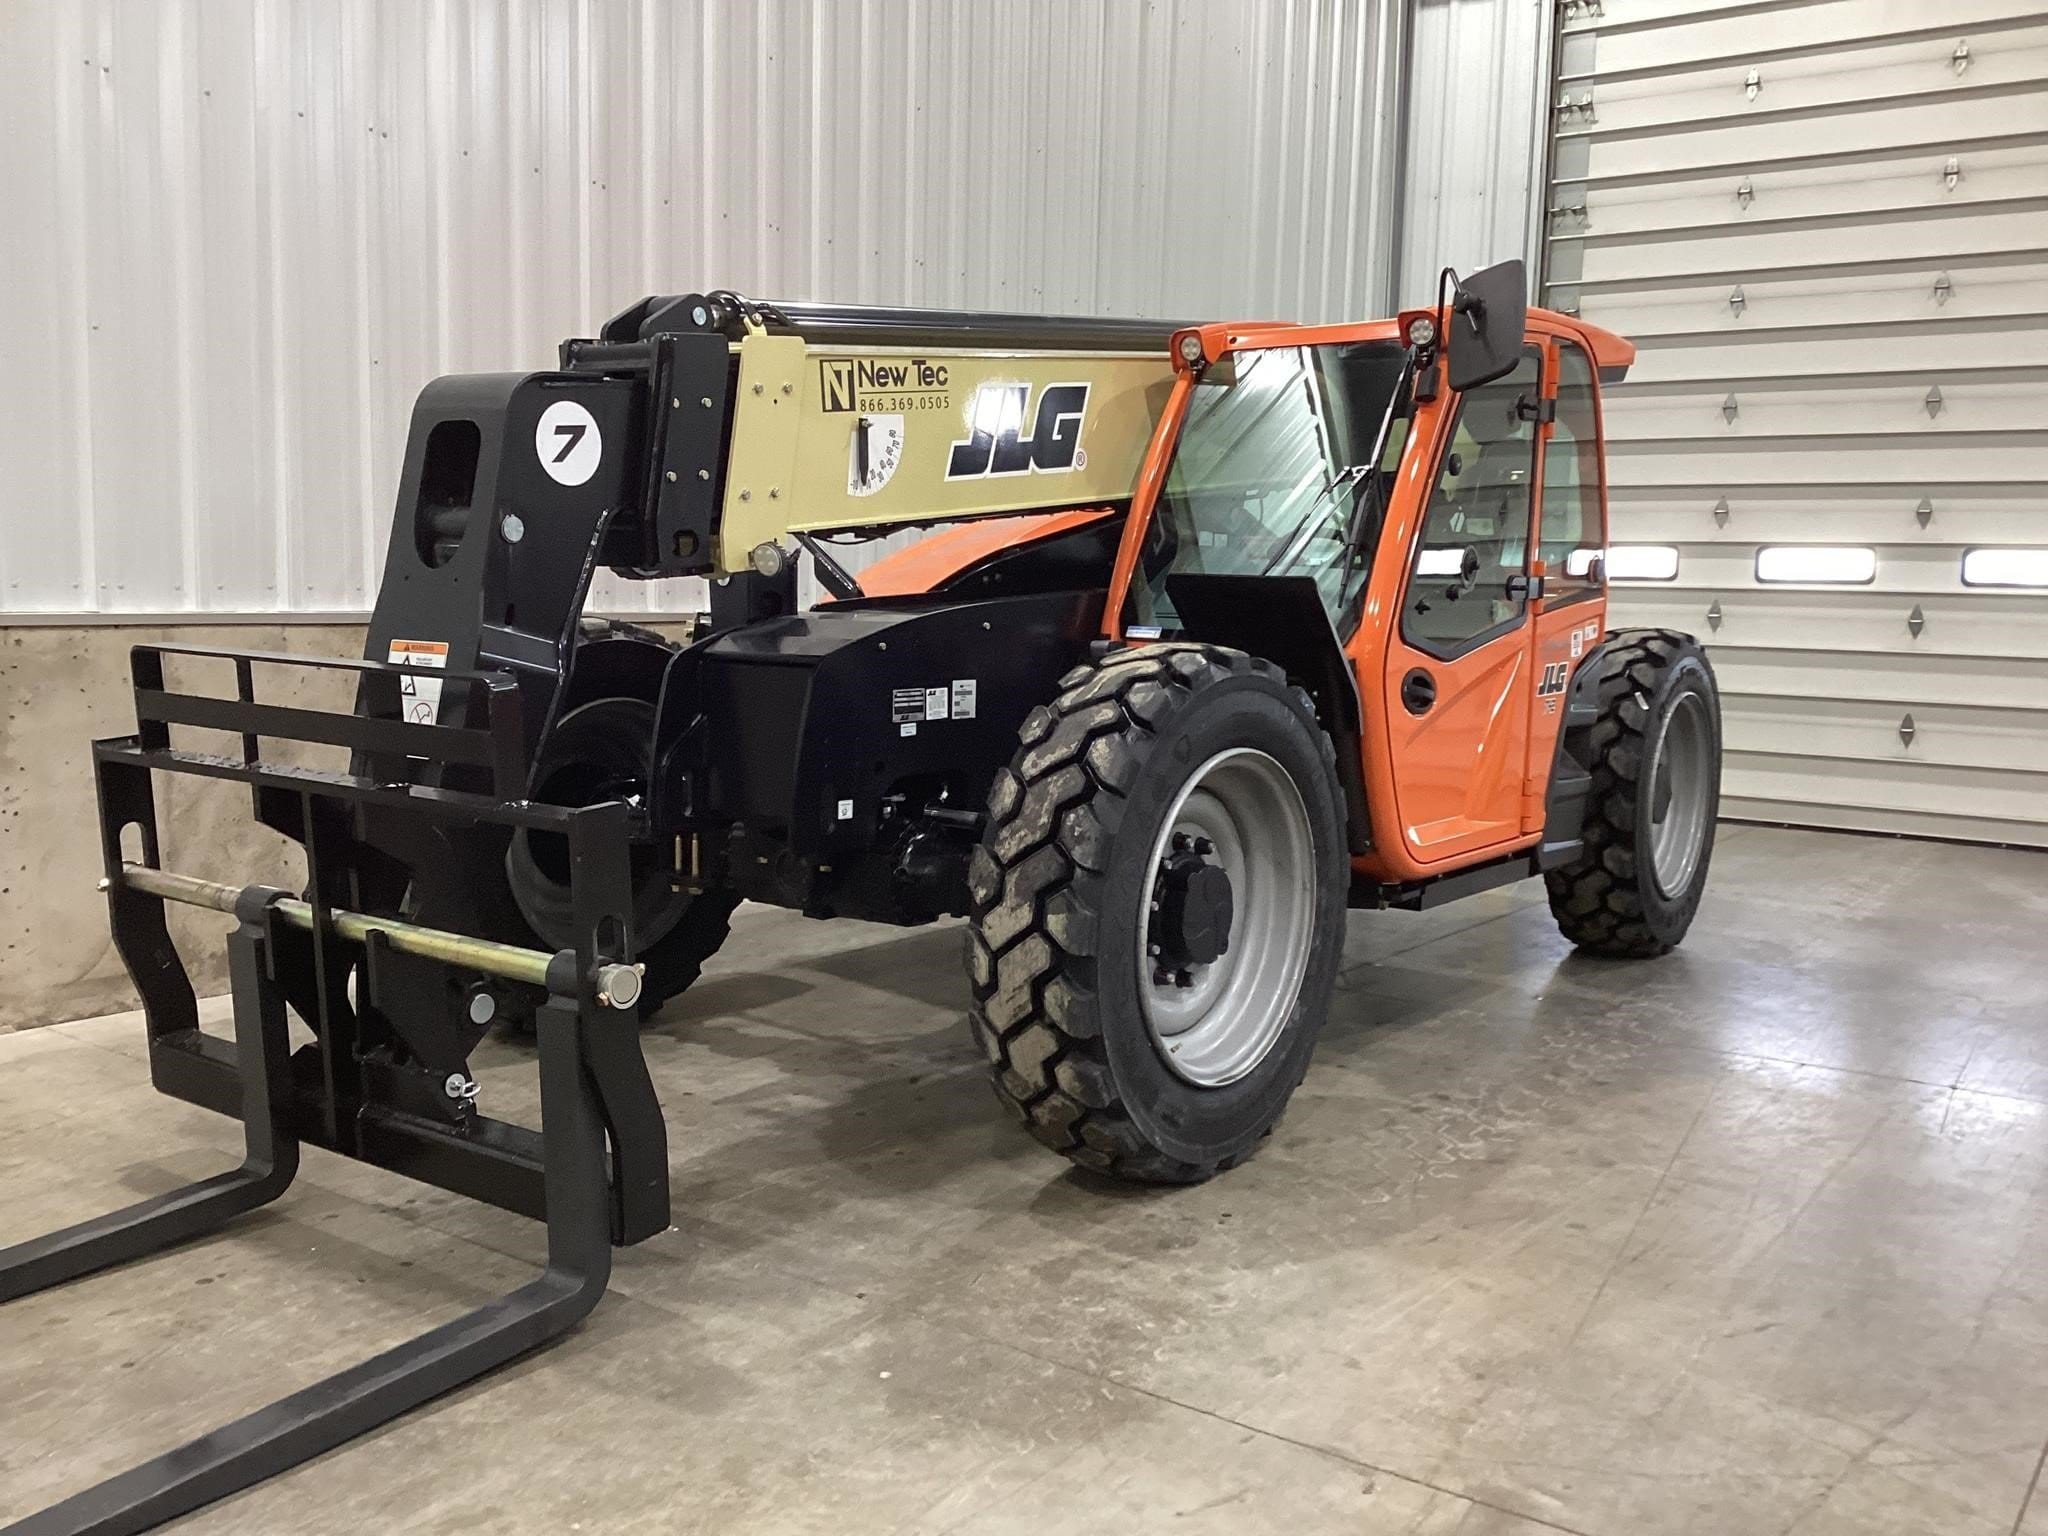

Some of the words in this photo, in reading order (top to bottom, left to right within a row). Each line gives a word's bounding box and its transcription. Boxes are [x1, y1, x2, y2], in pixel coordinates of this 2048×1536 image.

[858, 360, 908, 388] New
[912, 360, 948, 387] Tec
[860, 396, 949, 412] 866.369.0505
[552, 424, 587, 463] 7
[945, 383, 1091, 481] JLG
[1536, 661, 1569, 697] JLG
